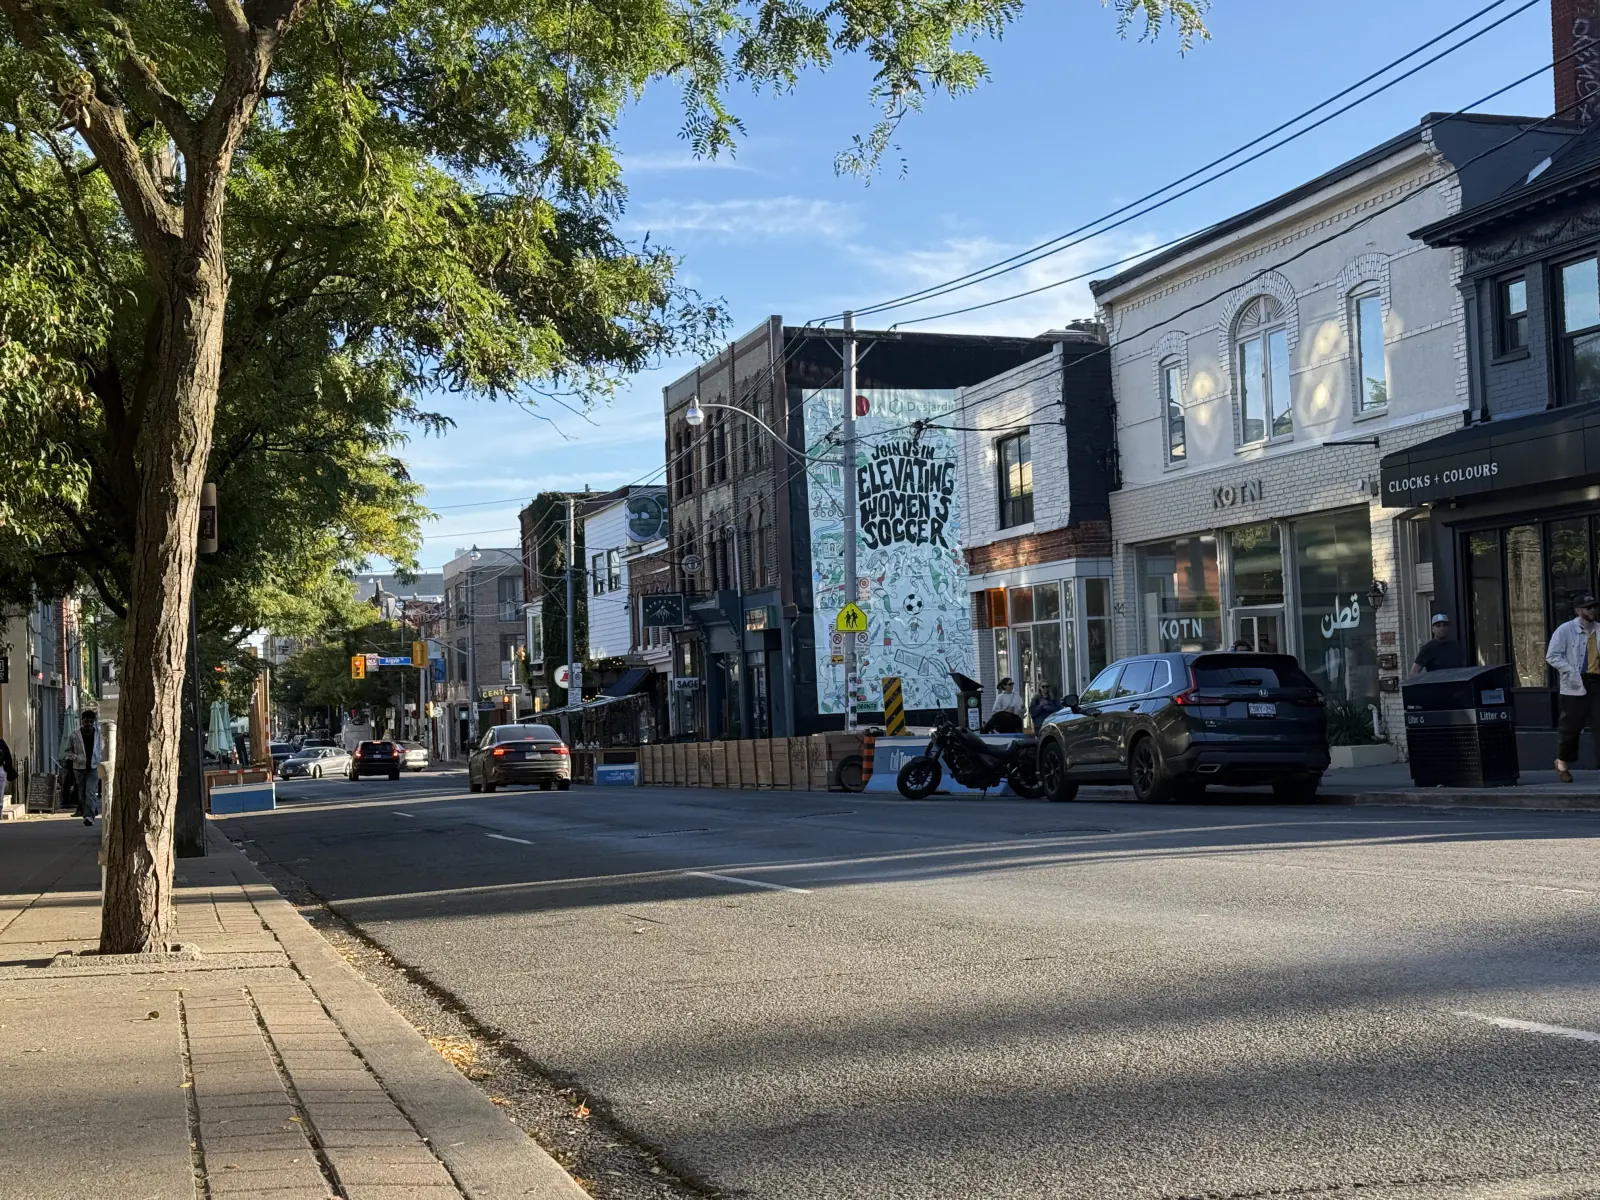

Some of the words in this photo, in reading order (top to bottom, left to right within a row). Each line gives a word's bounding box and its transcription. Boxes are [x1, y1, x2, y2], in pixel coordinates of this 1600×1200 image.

[871, 441, 900, 460] JOIN
[903, 440, 919, 457] US
[921, 445, 935, 460] IN
[857, 457, 955, 502] ELEVATING
[1388, 474, 1431, 493] CLOCKS
[1443, 462, 1499, 483] COLOURS
[1211, 478, 1263, 509] KOTN
[860, 491, 952, 529] WOMEN'S
[862, 517, 949, 550] SOCCER
[1159, 617, 1203, 640] KOTN
[1320, 593, 1361, 639] قطن
[676, 680, 698, 689] SAGE
[1479, 711, 1498, 721] Litter
